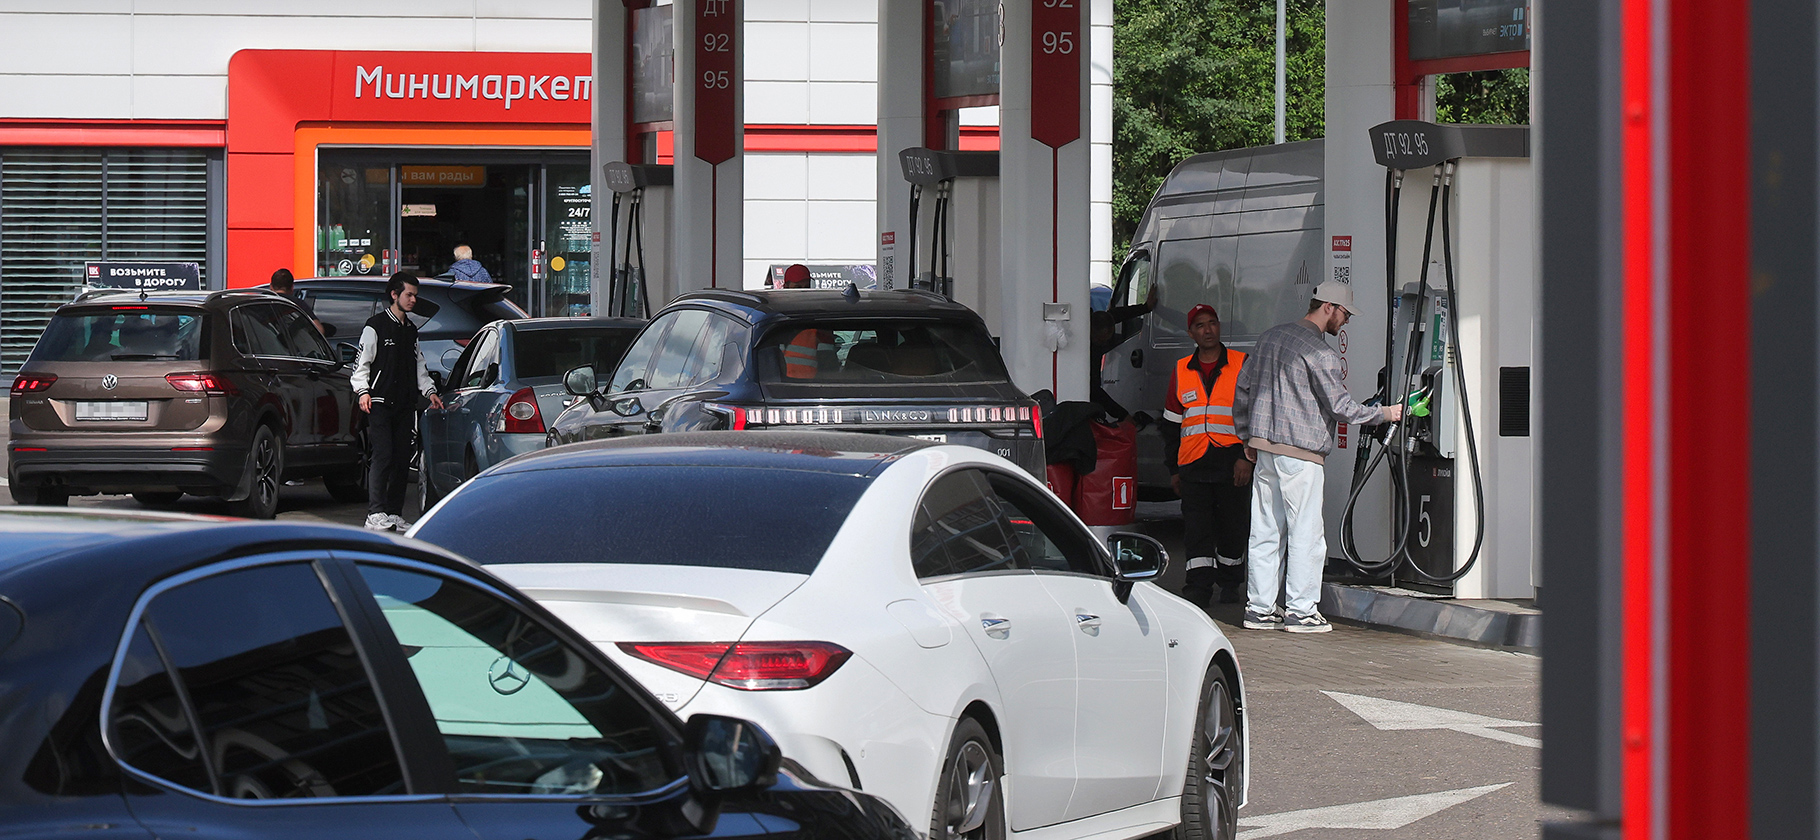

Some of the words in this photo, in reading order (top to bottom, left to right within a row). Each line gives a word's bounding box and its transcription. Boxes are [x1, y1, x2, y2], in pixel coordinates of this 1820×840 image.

[704, 0, 729, 17] ДТ
[703, 33, 730, 52] 92
[1042, 31, 1074, 54] 95
[703, 70, 730, 89] 95
[1384, 132, 1398, 159] ДТ
[1398, 132, 1413, 155] 92
[1414, 132, 1429, 155] 95
[411, 171, 435, 180] вам
[439, 171, 474, 183] рады
[568, 207, 591, 217] 24/7
[110, 268, 167, 277] ВОЗЬМИТЕ
[143, 278, 187, 287] ДОРОГУ
[997, 448, 1011, 457] 001
[1418, 495, 1432, 548] 5
